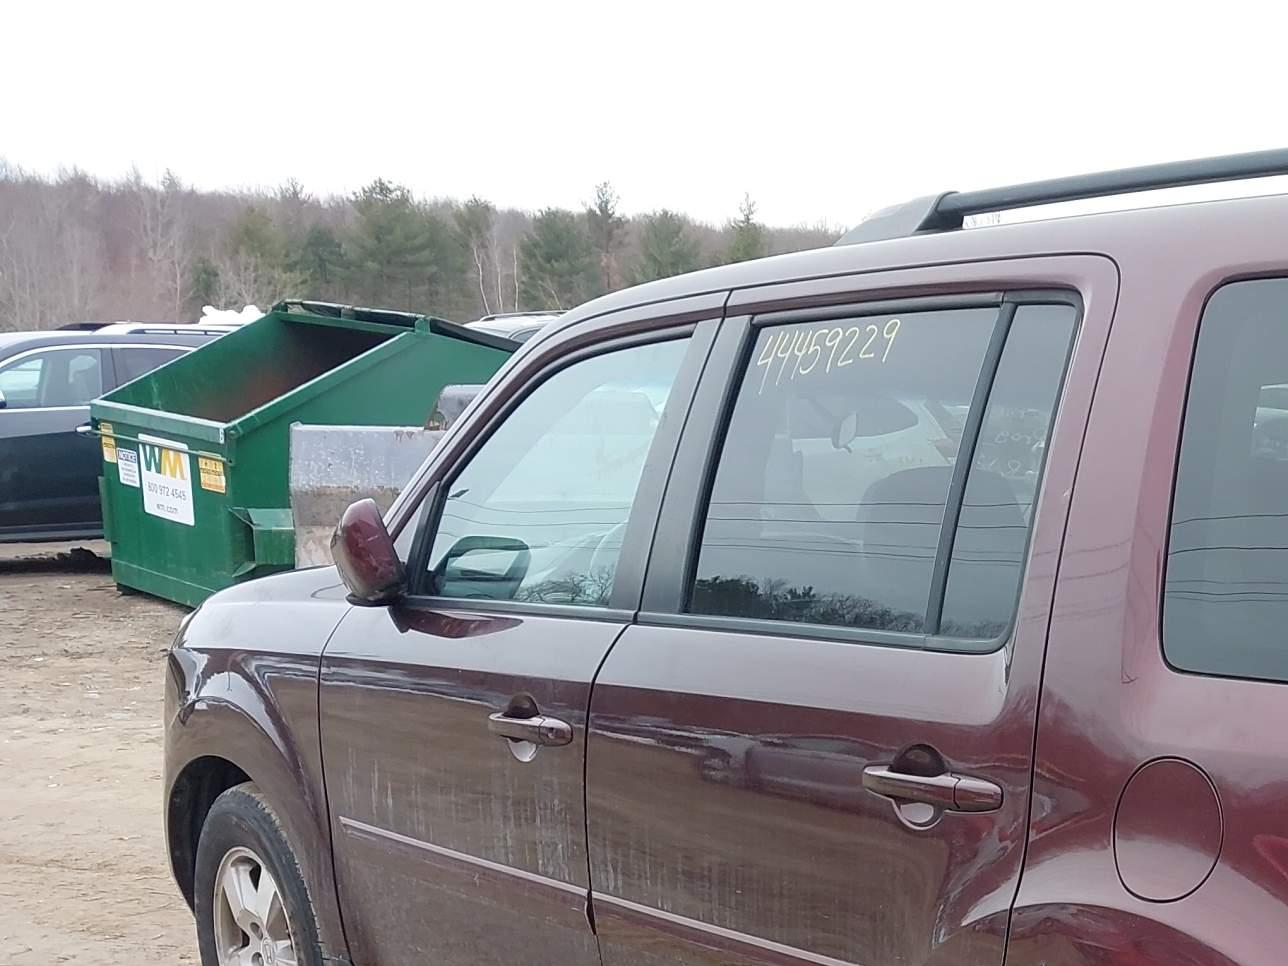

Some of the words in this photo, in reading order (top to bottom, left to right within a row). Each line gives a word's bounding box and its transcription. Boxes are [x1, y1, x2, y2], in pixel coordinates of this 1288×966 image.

[757, 319, 901, 395] 44459229
[139, 444, 186, 480] WM
[159, 483, 170, 497] 972
